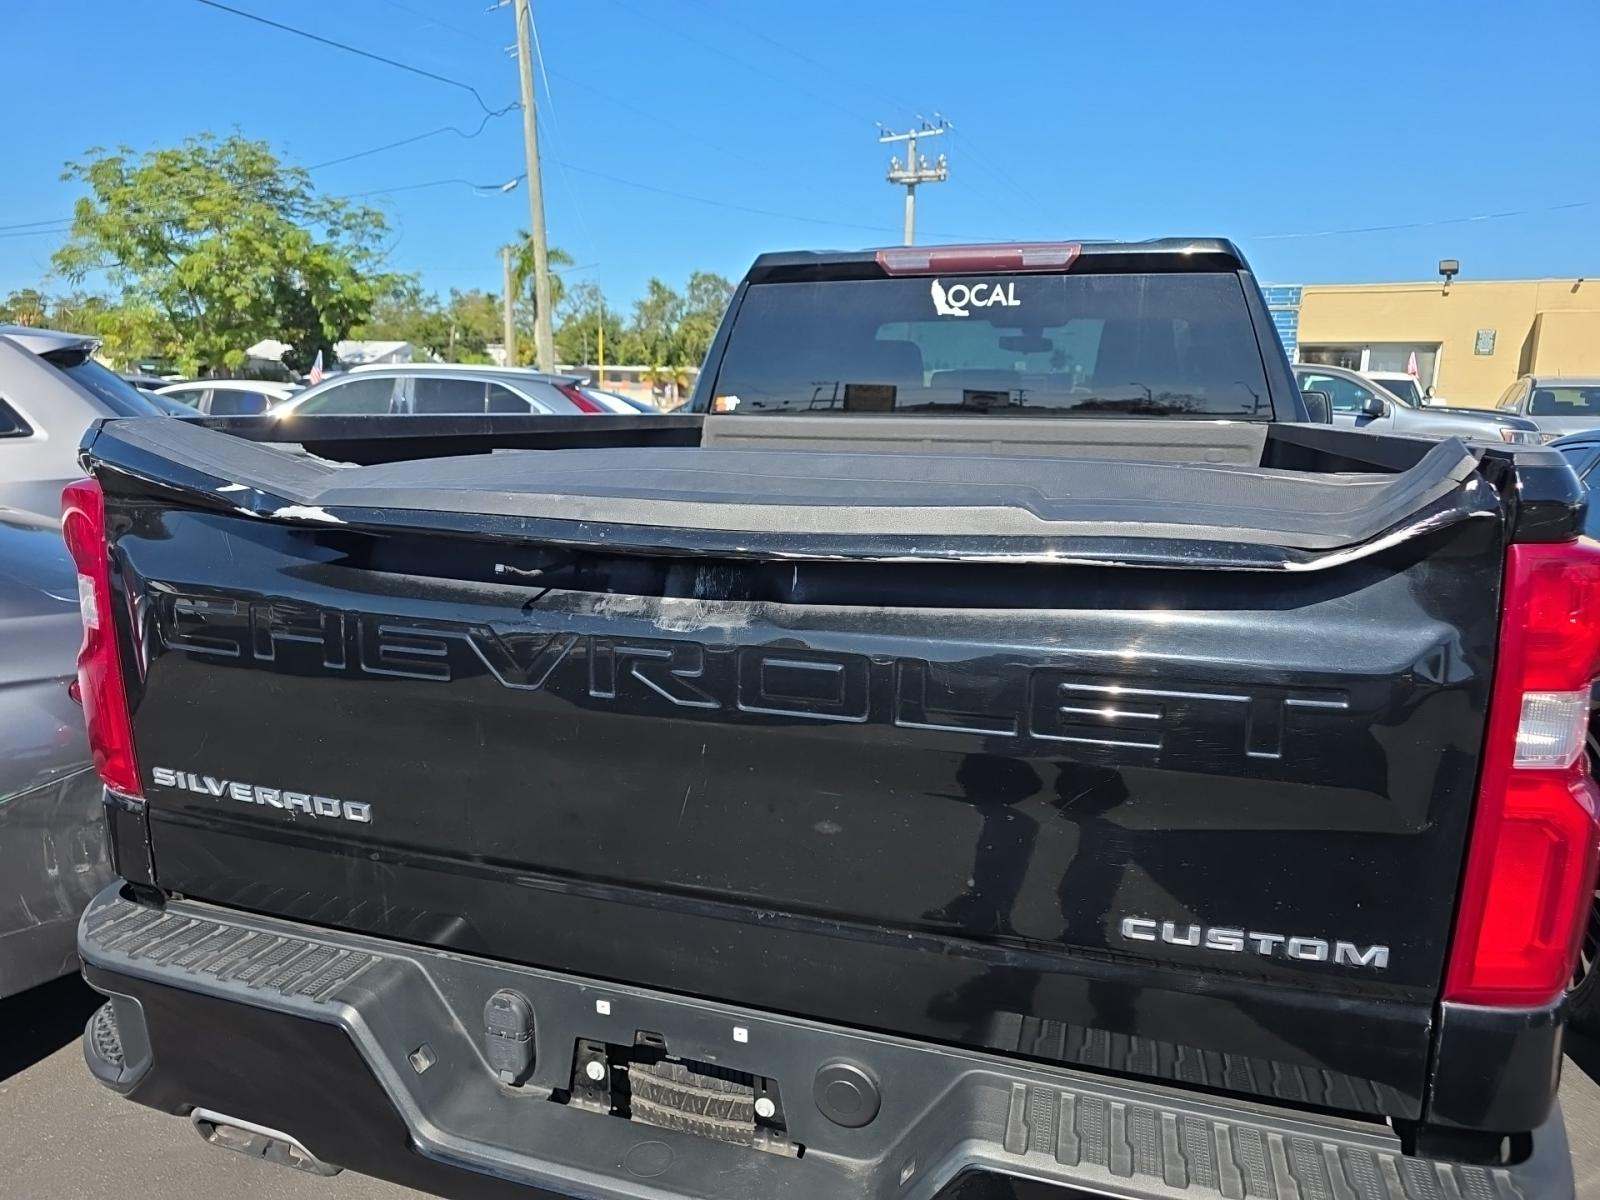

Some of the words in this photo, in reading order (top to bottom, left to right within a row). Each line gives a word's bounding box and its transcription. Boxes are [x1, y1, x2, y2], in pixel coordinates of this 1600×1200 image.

[931, 279, 1020, 316] LOCAL
[160, 594, 1350, 758] CHEVROLET
[152, 767, 372, 824] SILVERADO
[1121, 918, 1390, 968] CUSTOM
